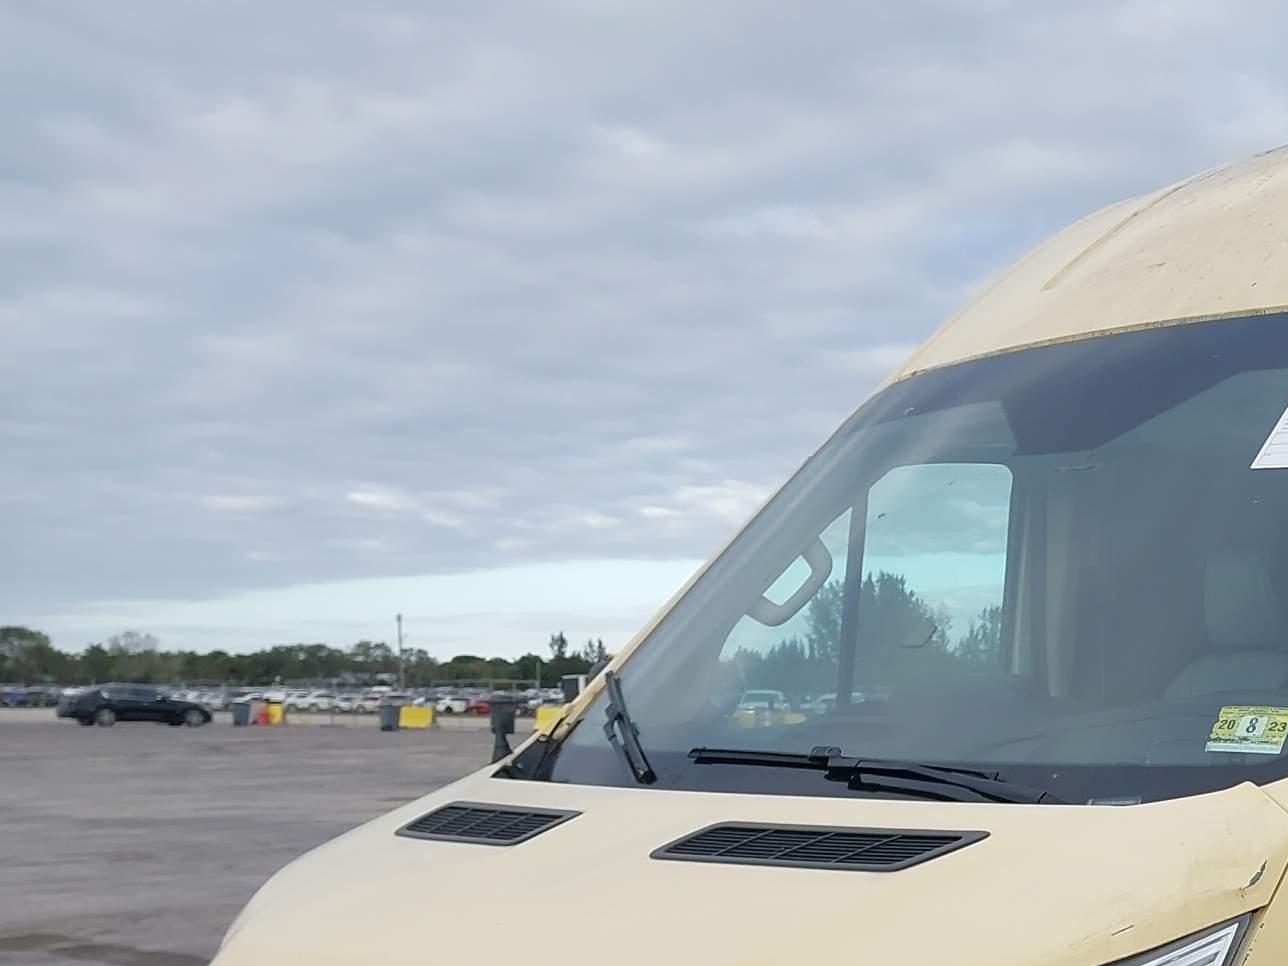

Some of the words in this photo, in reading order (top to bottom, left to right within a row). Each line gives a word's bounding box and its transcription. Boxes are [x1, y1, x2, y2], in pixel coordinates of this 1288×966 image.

[1218, 719, 1236, 730] 20
[1246, 717, 1258, 733] 8
[1268, 721, 1288, 732] 23
